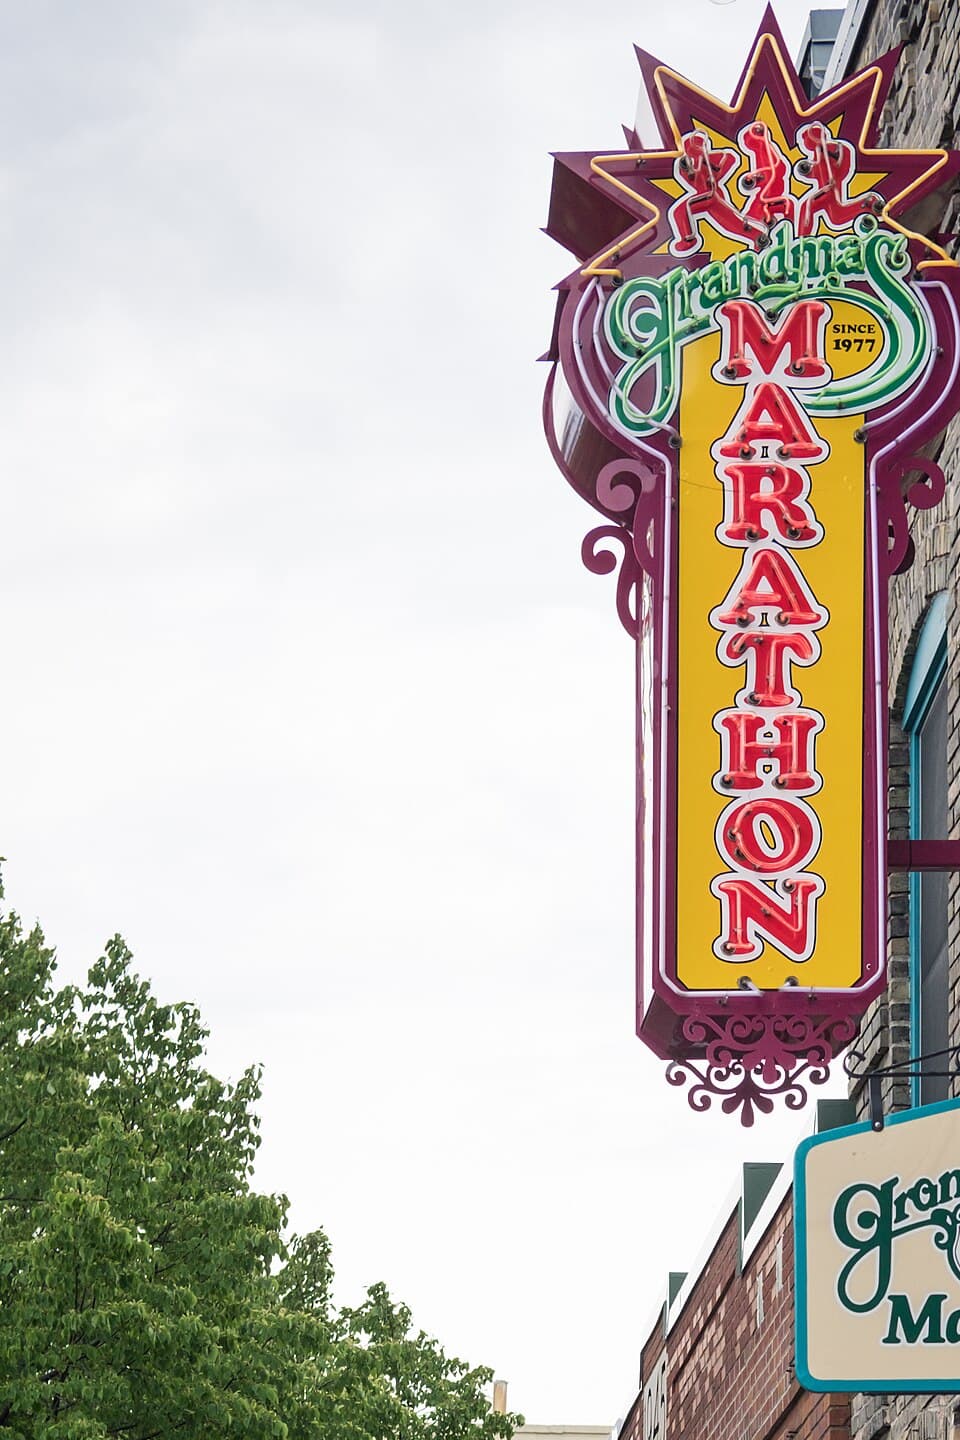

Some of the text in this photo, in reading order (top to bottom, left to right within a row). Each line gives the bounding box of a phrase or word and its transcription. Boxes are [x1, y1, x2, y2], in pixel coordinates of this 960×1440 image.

[832, 323, 876, 335] SINCE
[832, 339, 876, 353] 1977
[719, 302, 824, 955] MARATHON
